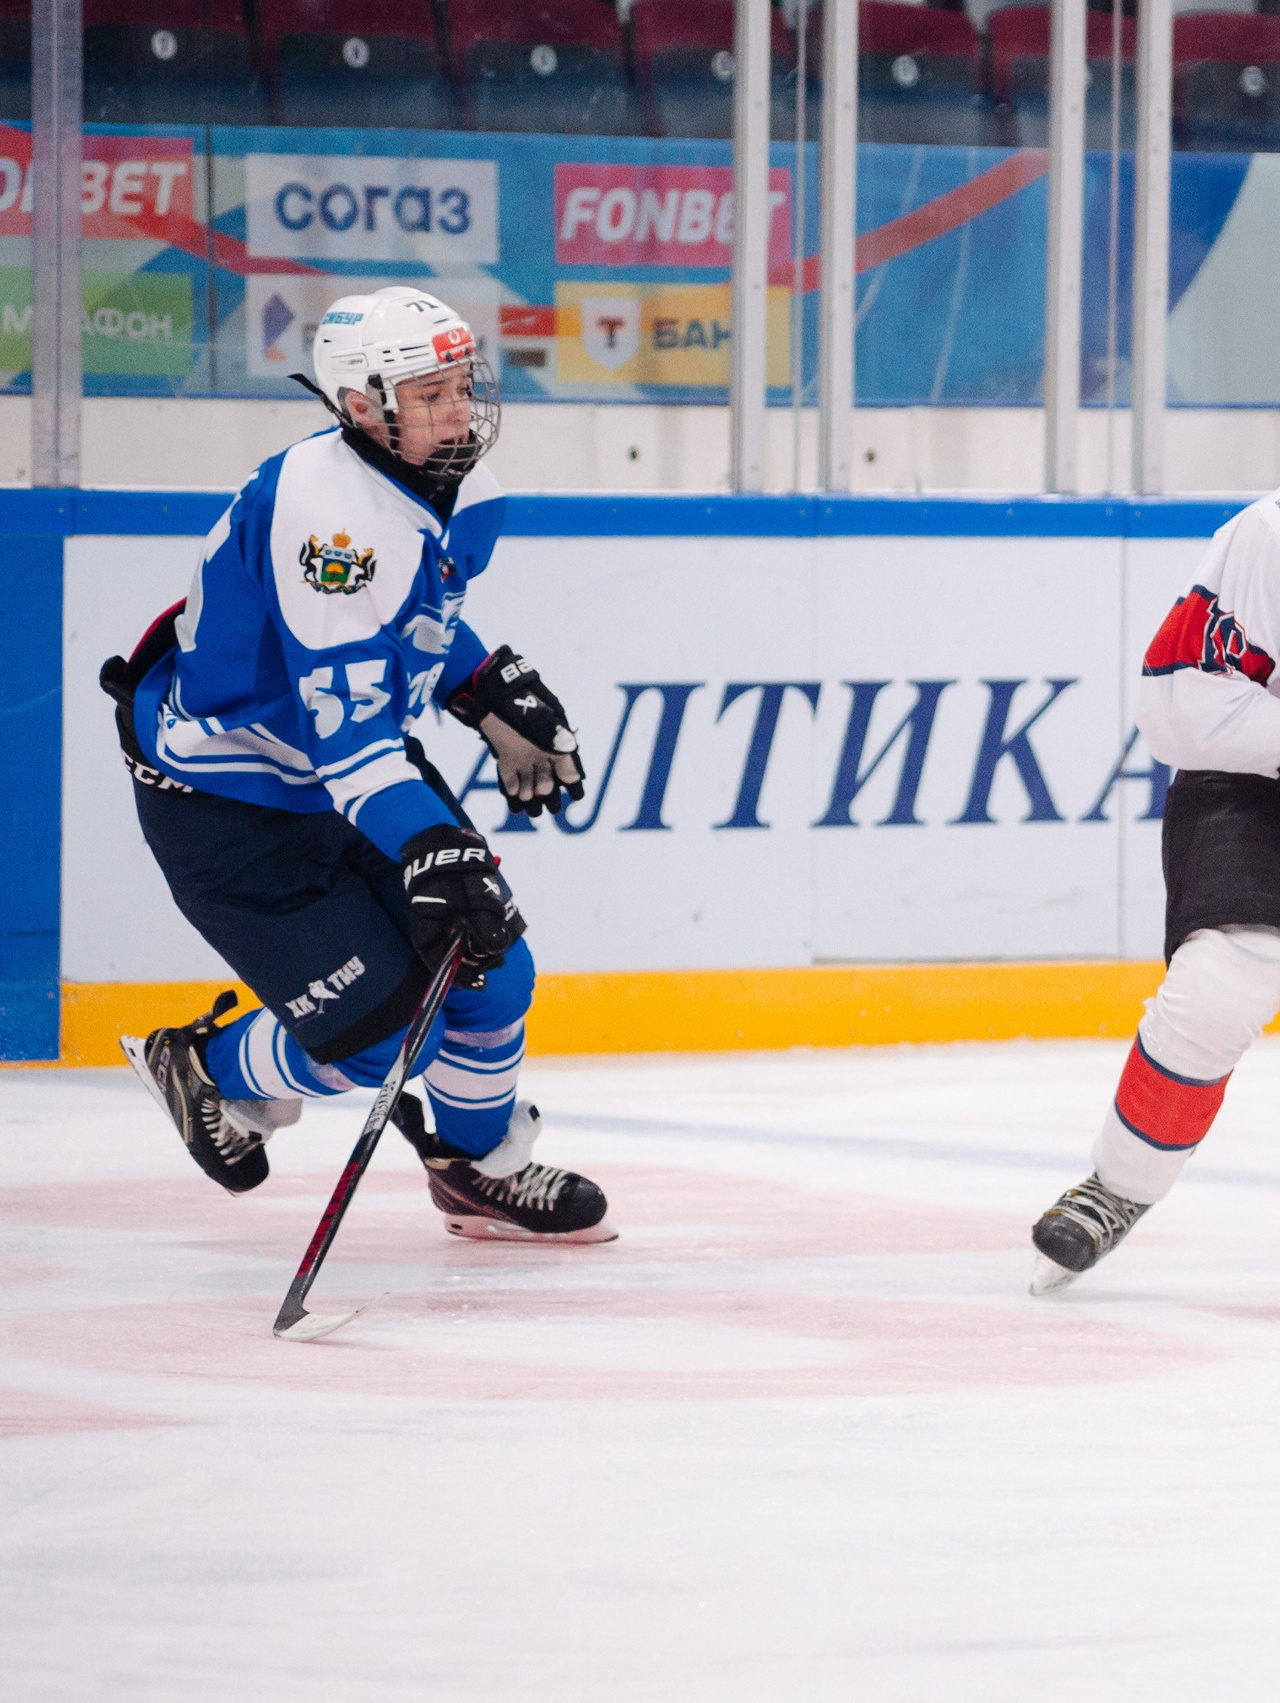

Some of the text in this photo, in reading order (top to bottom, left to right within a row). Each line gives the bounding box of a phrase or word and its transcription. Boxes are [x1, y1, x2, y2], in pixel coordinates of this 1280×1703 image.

[0, 157, 187, 214] OBET
[653, 318, 731, 350] БАН
[299, 659, 391, 739] 55
